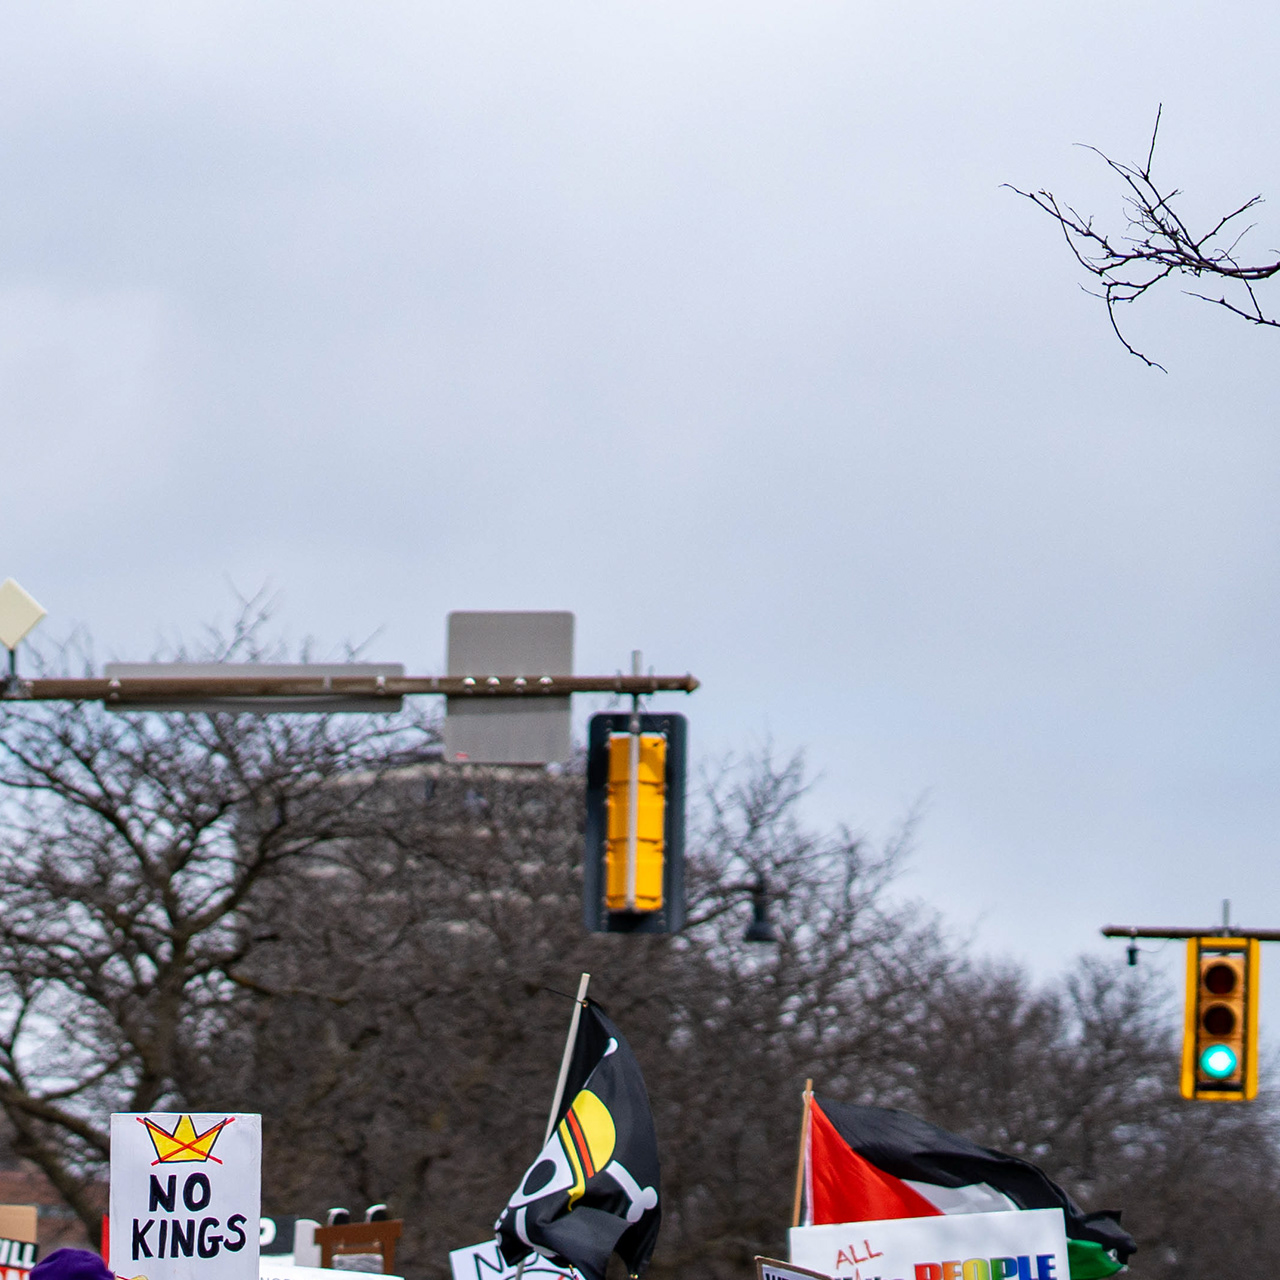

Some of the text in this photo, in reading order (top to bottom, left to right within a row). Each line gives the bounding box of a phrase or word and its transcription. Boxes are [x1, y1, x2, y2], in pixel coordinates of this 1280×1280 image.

[149, 1172, 211, 1213] NO
[132, 1214, 247, 1260] KINGS
[836, 1239, 883, 1270] ALL
